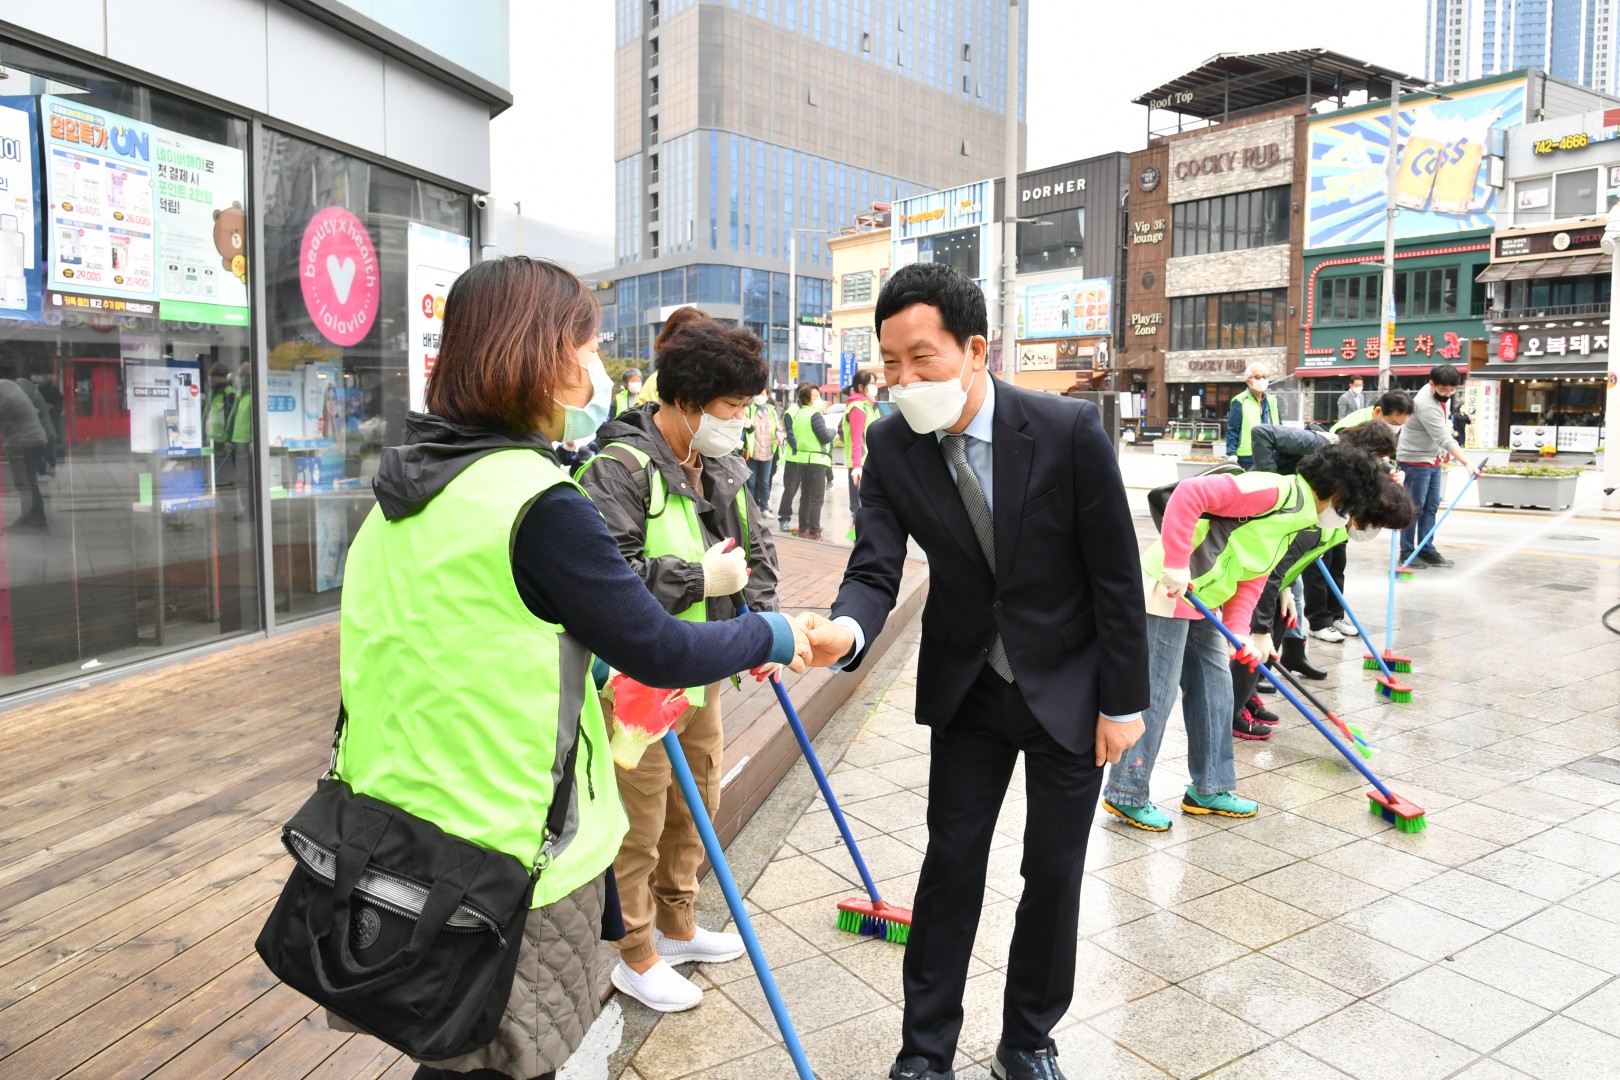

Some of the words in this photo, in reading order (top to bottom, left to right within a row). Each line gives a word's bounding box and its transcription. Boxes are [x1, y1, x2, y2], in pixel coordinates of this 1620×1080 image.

[1149, 94, 1172, 111] Roof
[1174, 91, 1194, 104] Top
[110, 123, 150, 162] ON
[1533, 133, 1588, 155] 742-4666
[157, 146, 214, 173] 네이버페이로
[1174, 151, 1237, 180] COCKY
[1411, 137, 1469, 176] Cass
[158, 164, 167, 178] 첫
[169, 167, 188, 183] 결제
[190, 172, 200, 186] 시
[159, 181, 187, 199] 포인트
[1022, 178, 1086, 202] DORMER
[160, 198, 180, 214] 적립!
[1134, 221, 1151, 233] Vip
[1133, 232, 1164, 245] lounge
[1134, 325, 1157, 336] Zone
